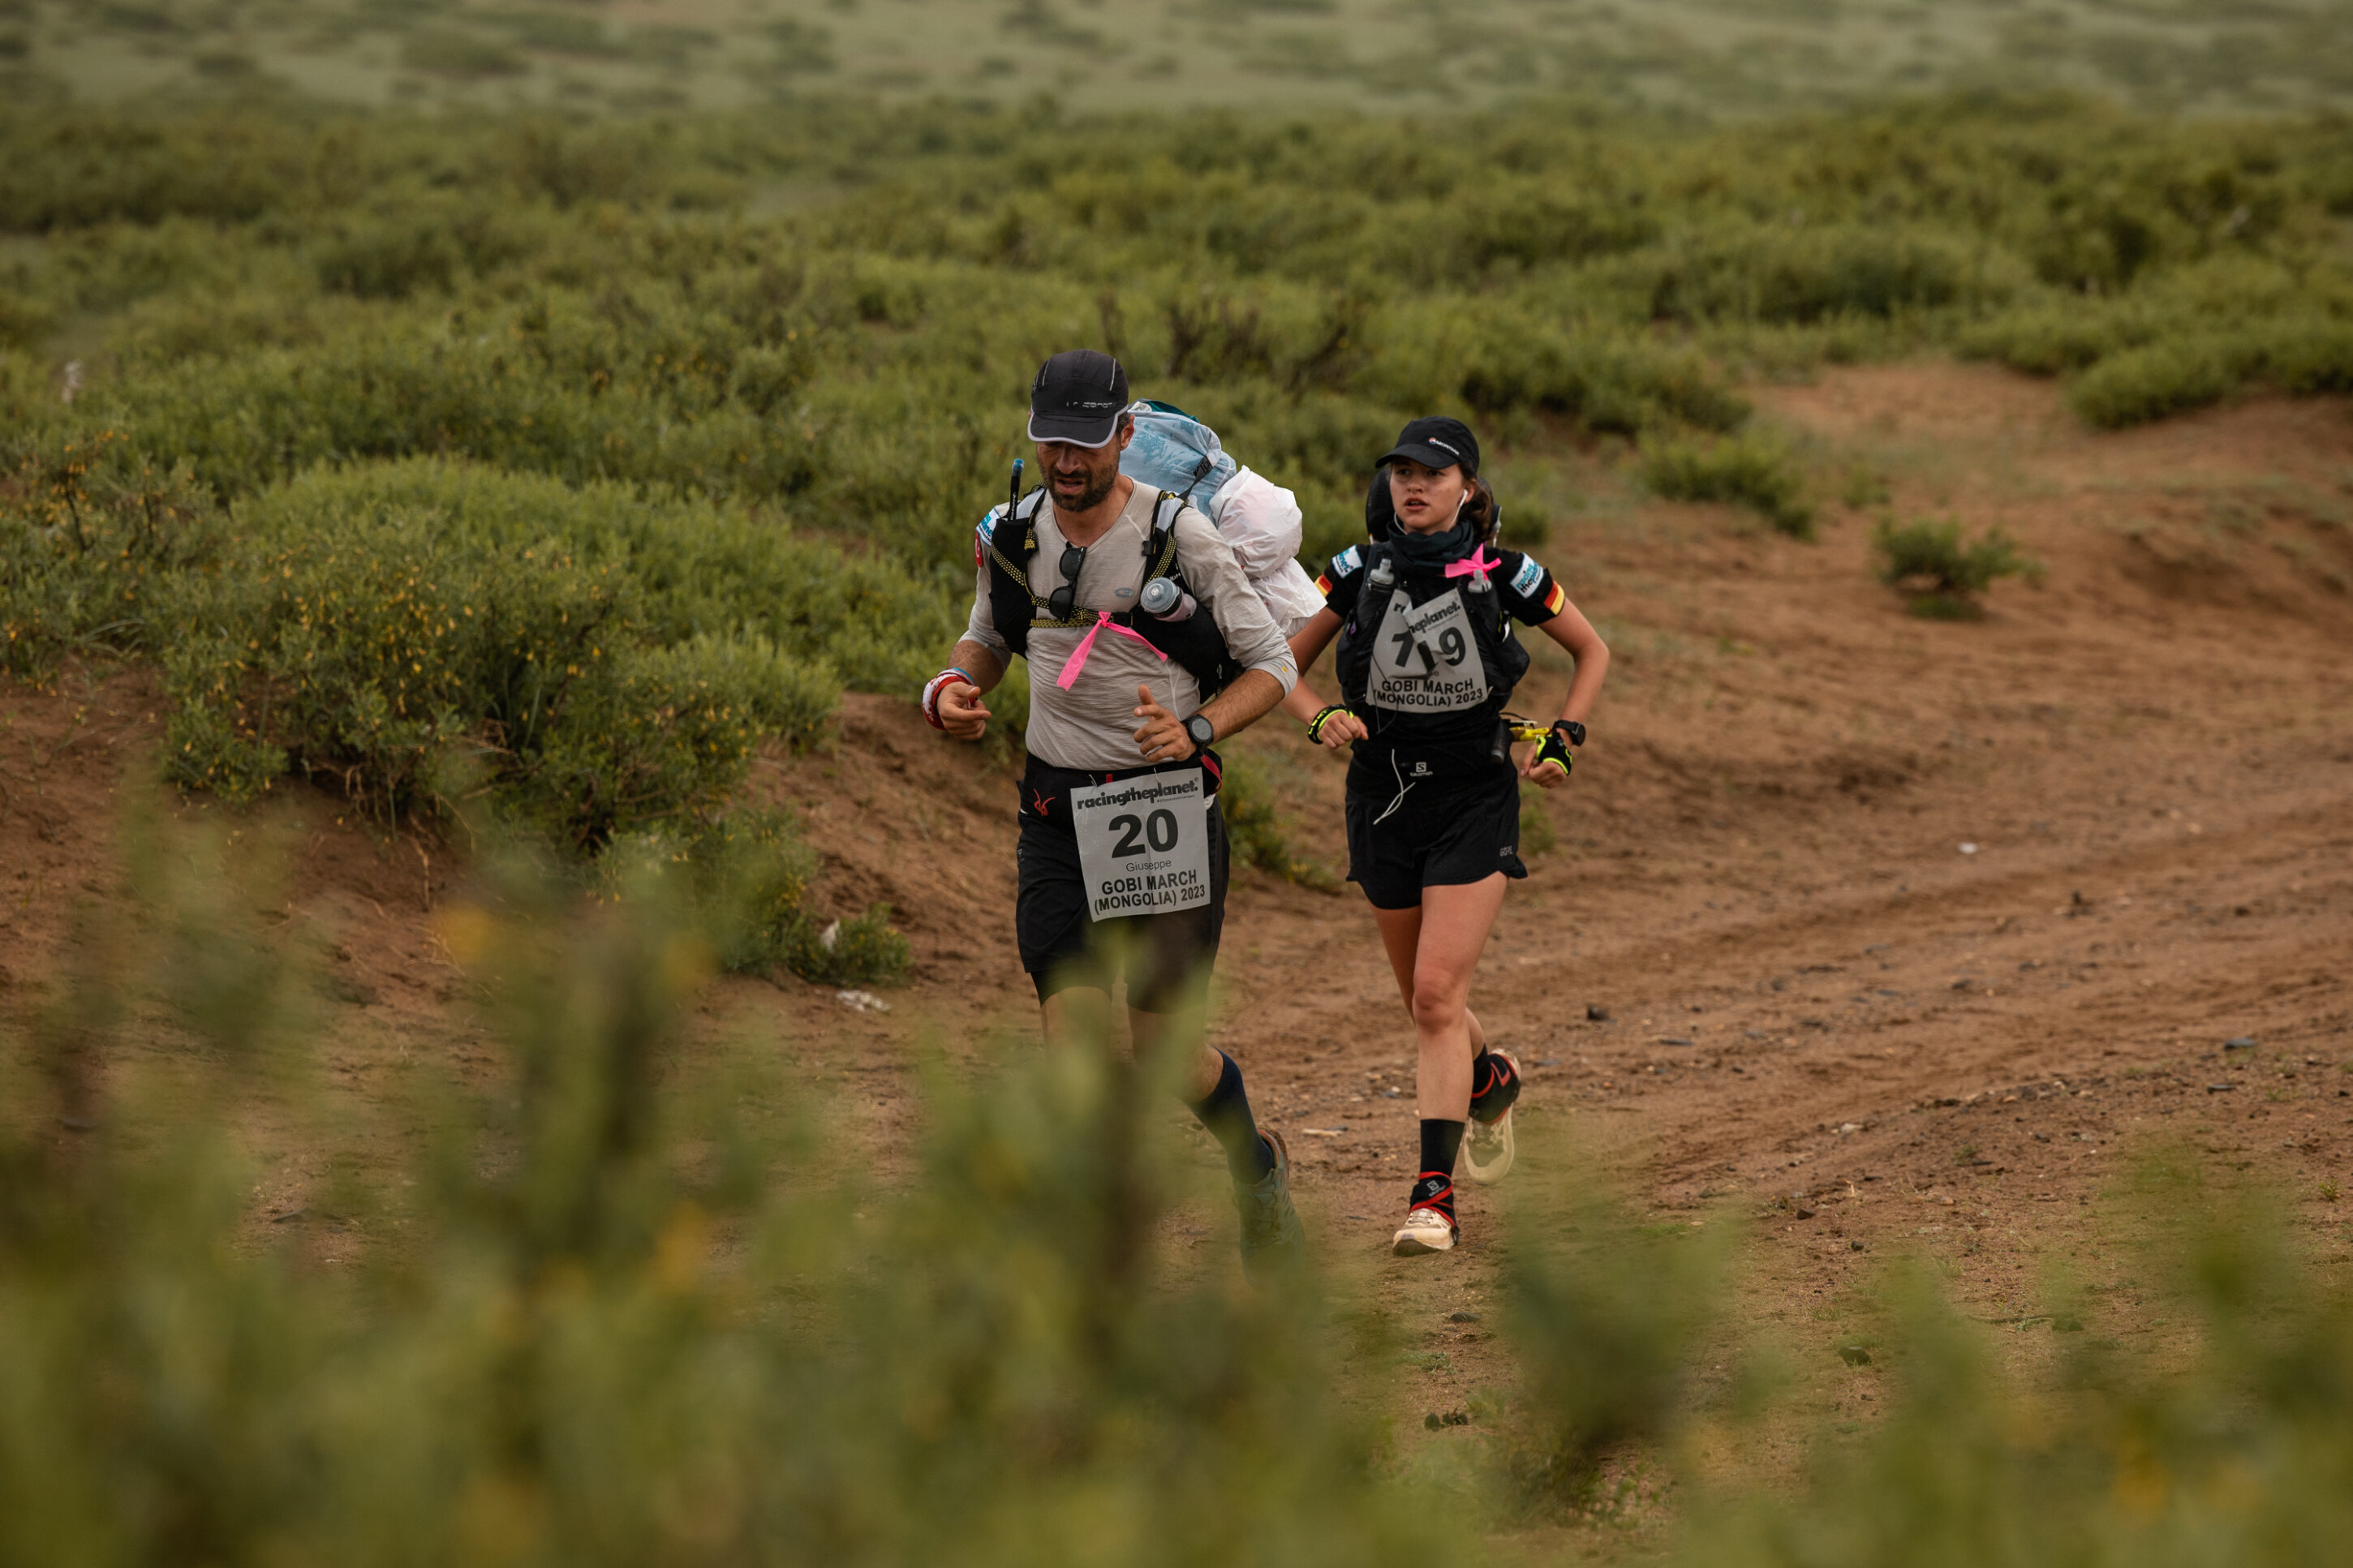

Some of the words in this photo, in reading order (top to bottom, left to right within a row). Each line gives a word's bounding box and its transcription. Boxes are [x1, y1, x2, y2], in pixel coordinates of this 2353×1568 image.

[1392, 626, 1466, 672] 719
[1373, 689, 1452, 707] (MONGOLIA)
[1456, 688, 1483, 704] 2023
[1382, 680, 1417, 693] GOBI
[1424, 678, 1473, 695] MARCH
[1108, 808, 1179, 858] 20
[1125, 860, 1172, 873] Giuseppe
[1101, 876, 1142, 895] GOBI
[1146, 869, 1197, 890] MARCH
[1095, 890, 1176, 915] (MONGOLIA)
[1181, 884, 1206, 902] 2023
